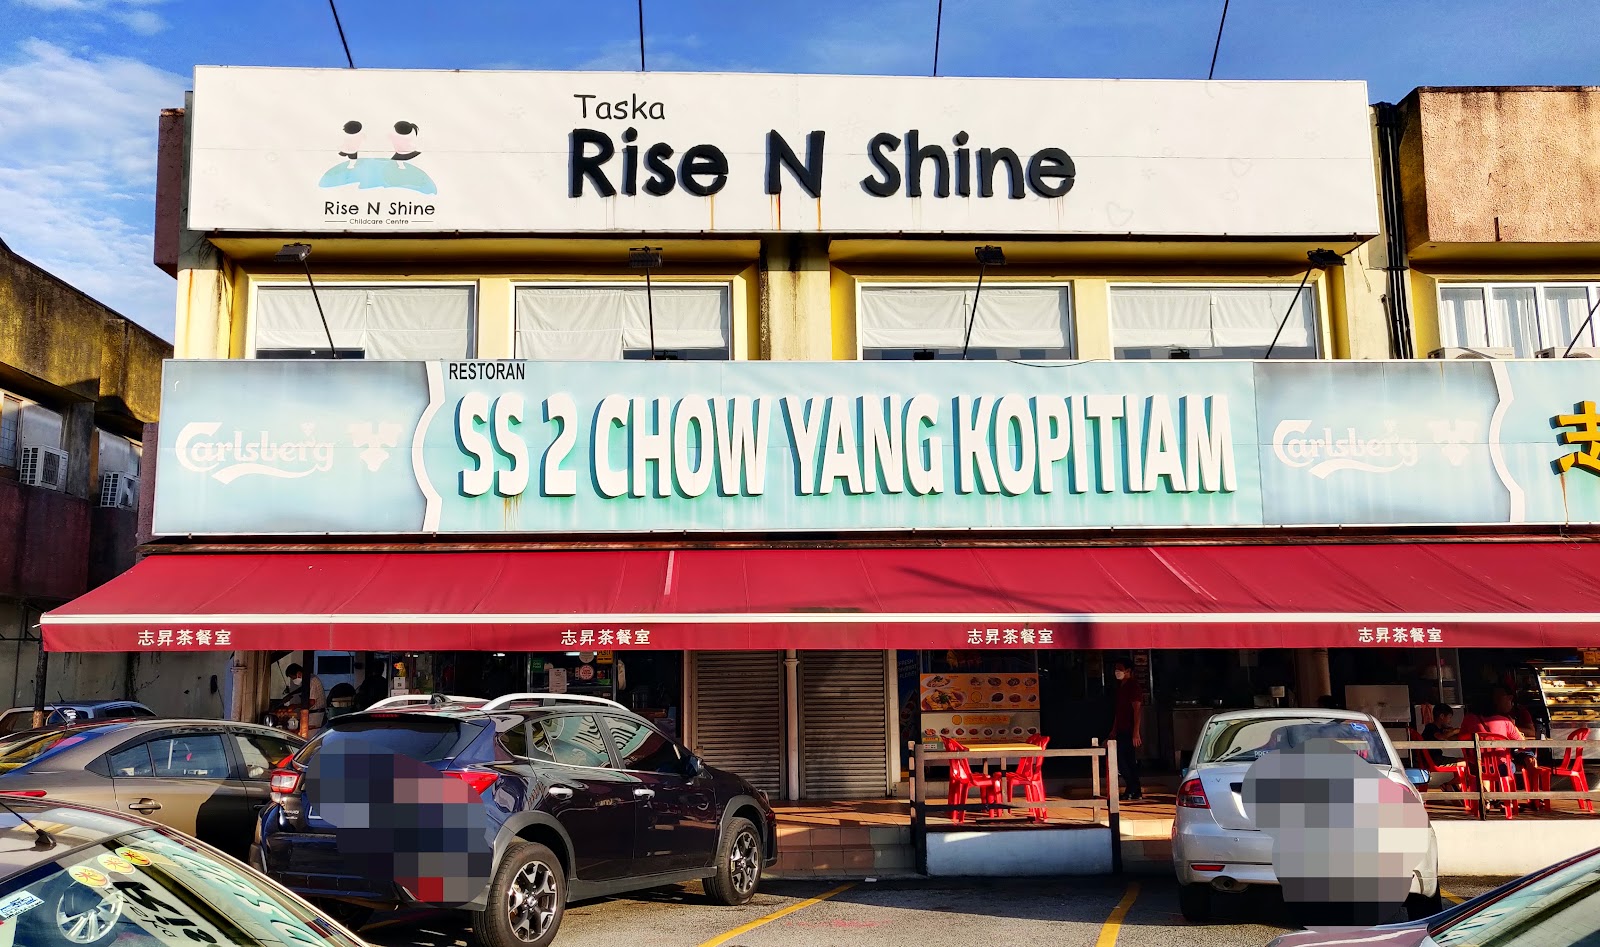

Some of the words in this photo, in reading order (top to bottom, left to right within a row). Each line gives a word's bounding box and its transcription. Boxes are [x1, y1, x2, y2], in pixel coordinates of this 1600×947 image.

[573, 93, 666, 120] Taska
[569, 126, 729, 198] Rise
[765, 129, 826, 198] N
[860, 129, 1076, 198] Shine
[324, 201, 359, 215] Rise
[367, 201, 381, 215] N
[388, 201, 435, 215] Shine
[449, 362, 525, 380] RESTORAN
[175, 422, 335, 473] Carlsberg
[454, 391, 530, 498] SS
[540, 391, 578, 498] 2
[590, 390, 772, 499] CHOW
[780, 393, 944, 496] YANG
[952, 393, 1238, 498] KOPITIAM
[1273, 419, 1419, 468] Carlsberg
[137, 629, 232, 646] 志昇茶餐室
[560, 628, 651, 646] 志昇茶餐室
[967, 628, 1054, 645] 志昇茶餐室
[1357, 626, 1444, 643] 志昇茶餐室
